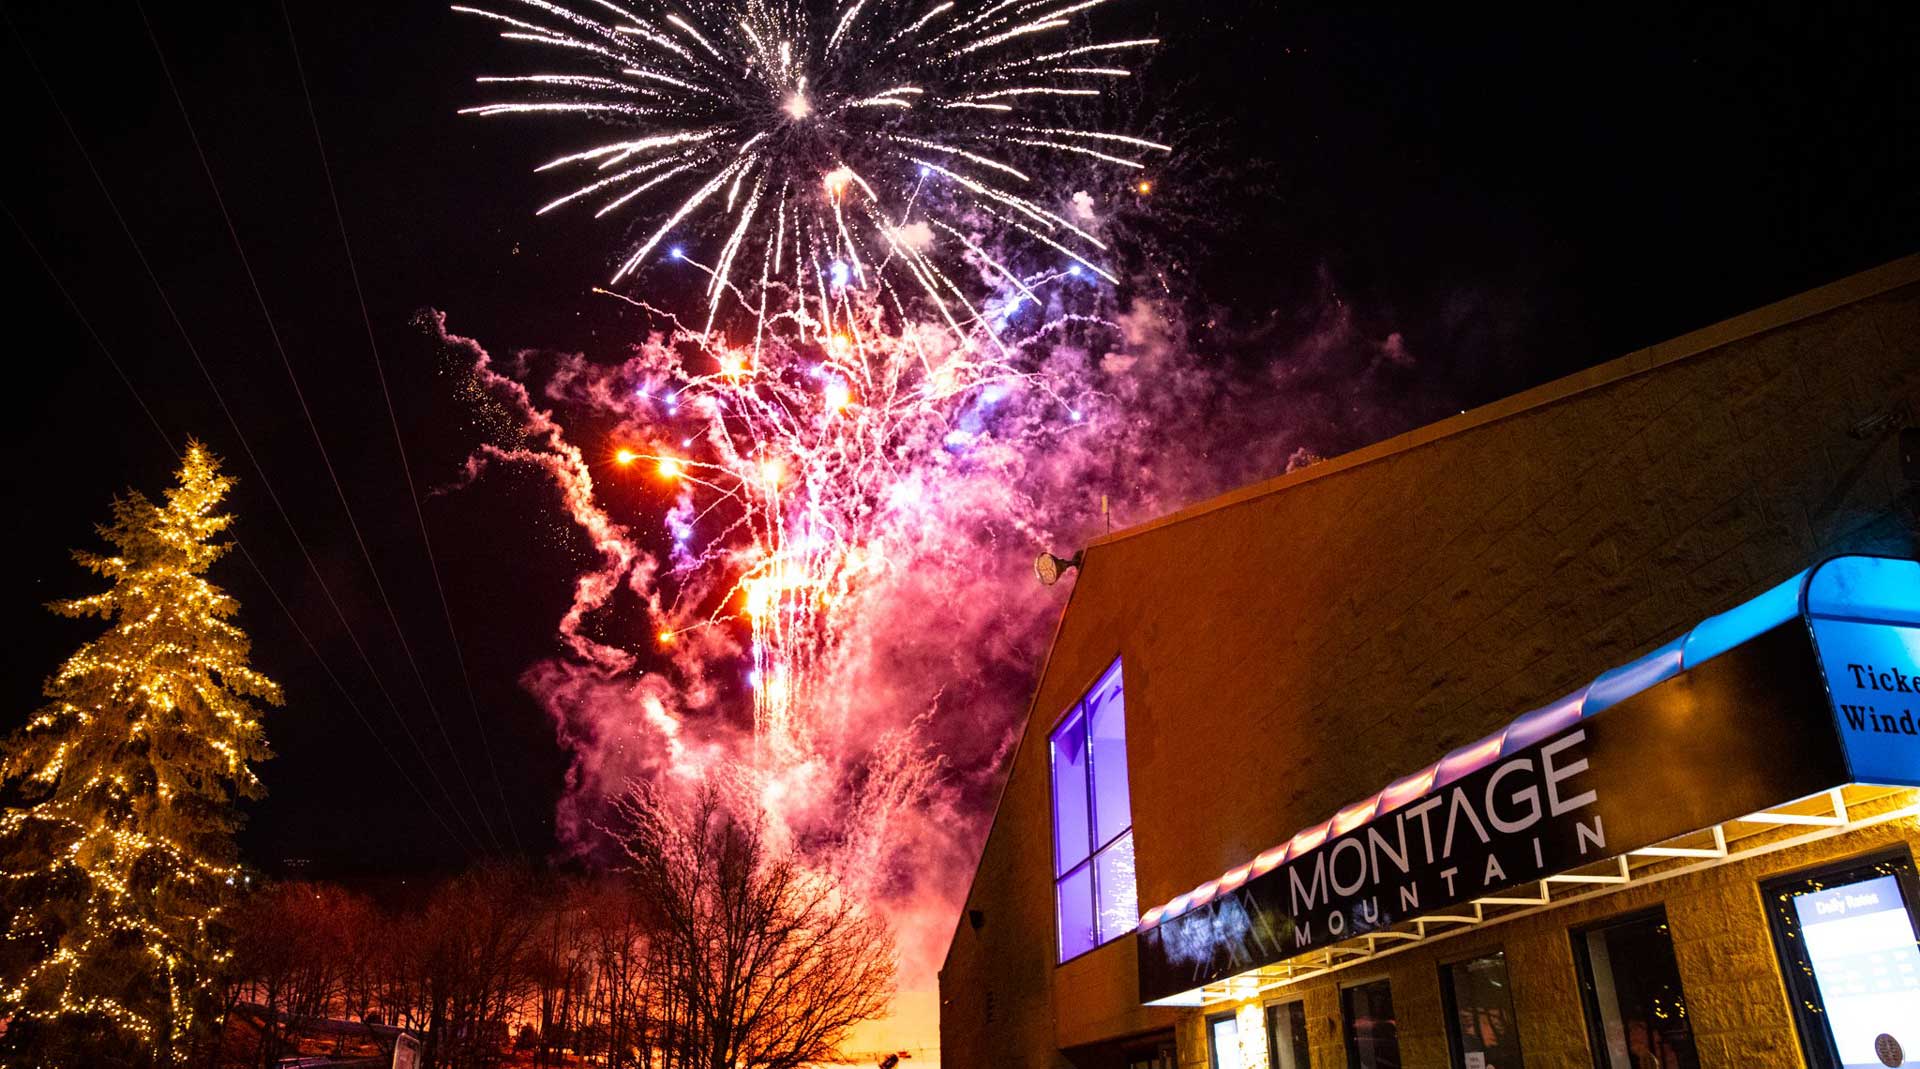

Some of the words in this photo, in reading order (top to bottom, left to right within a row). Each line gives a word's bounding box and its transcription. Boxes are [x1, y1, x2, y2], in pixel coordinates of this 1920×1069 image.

[1840, 704, 1920, 736] Wind
[1289, 729, 1598, 917] MONTAGE
[1294, 815, 1606, 948] MOUNTAIN
